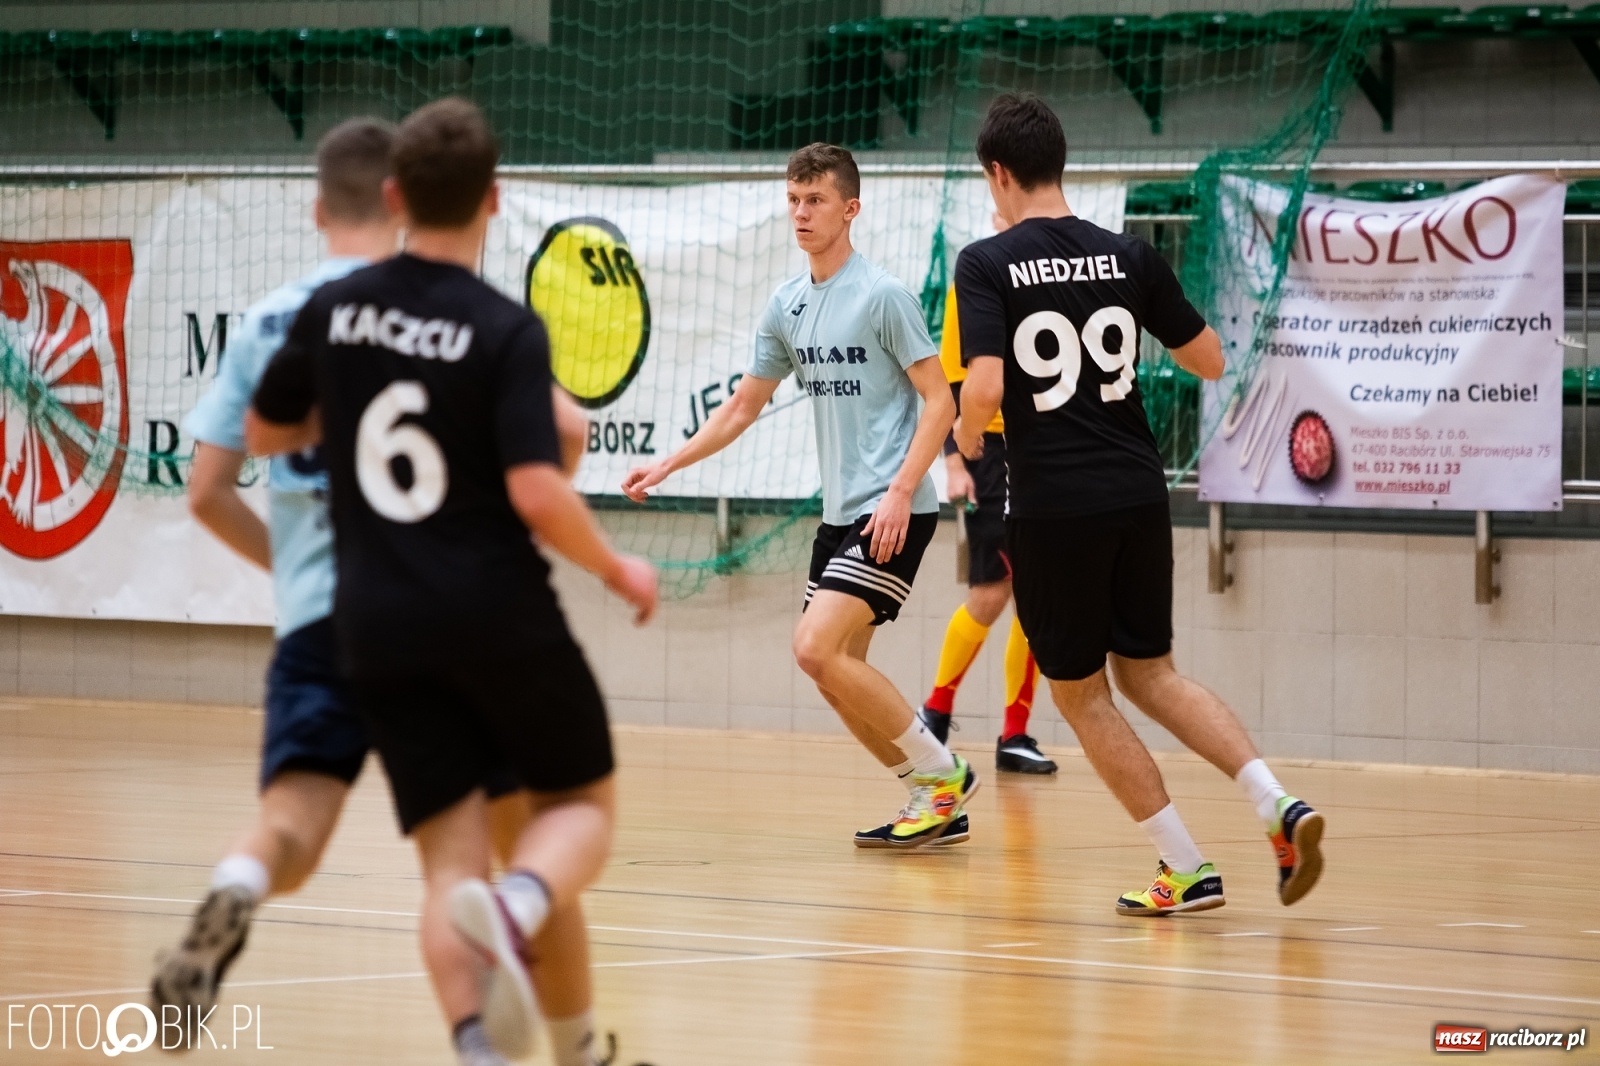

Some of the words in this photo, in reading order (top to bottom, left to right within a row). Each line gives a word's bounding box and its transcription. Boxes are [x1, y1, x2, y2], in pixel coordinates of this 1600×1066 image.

[1008, 255, 1126, 288] NIEDZIEL
[1409, 290, 1424, 302] na
[328, 303, 474, 362] KACZCU
[1339, 314, 1422, 338] urządzeń
[1429, 311, 1552, 335] cukierniczych
[1013, 306, 1137, 412] 99
[1253, 338, 1341, 360] Pracownik
[1348, 342, 1460, 364] produkcyjny
[1350, 384, 1431, 407] Czekamy
[1437, 387, 1460, 402] na
[1468, 384, 1538, 402] Ciebie!
[1351, 426, 1388, 440] Mieszko
[1391, 428, 1411, 440] BIS
[355, 379, 449, 523] 6
[1390, 443, 1436, 458] Racibórz
[1460, 444, 1533, 461] Starowiejska
[1353, 462, 1368, 473] tel.
[1374, 462, 1395, 474] 032
[1399, 462, 1421, 475] 796
[1425, 463, 1439, 475] 11
[1444, 462, 1461, 475] 33
[1355, 480, 1451, 494] www.mieszko.pl
